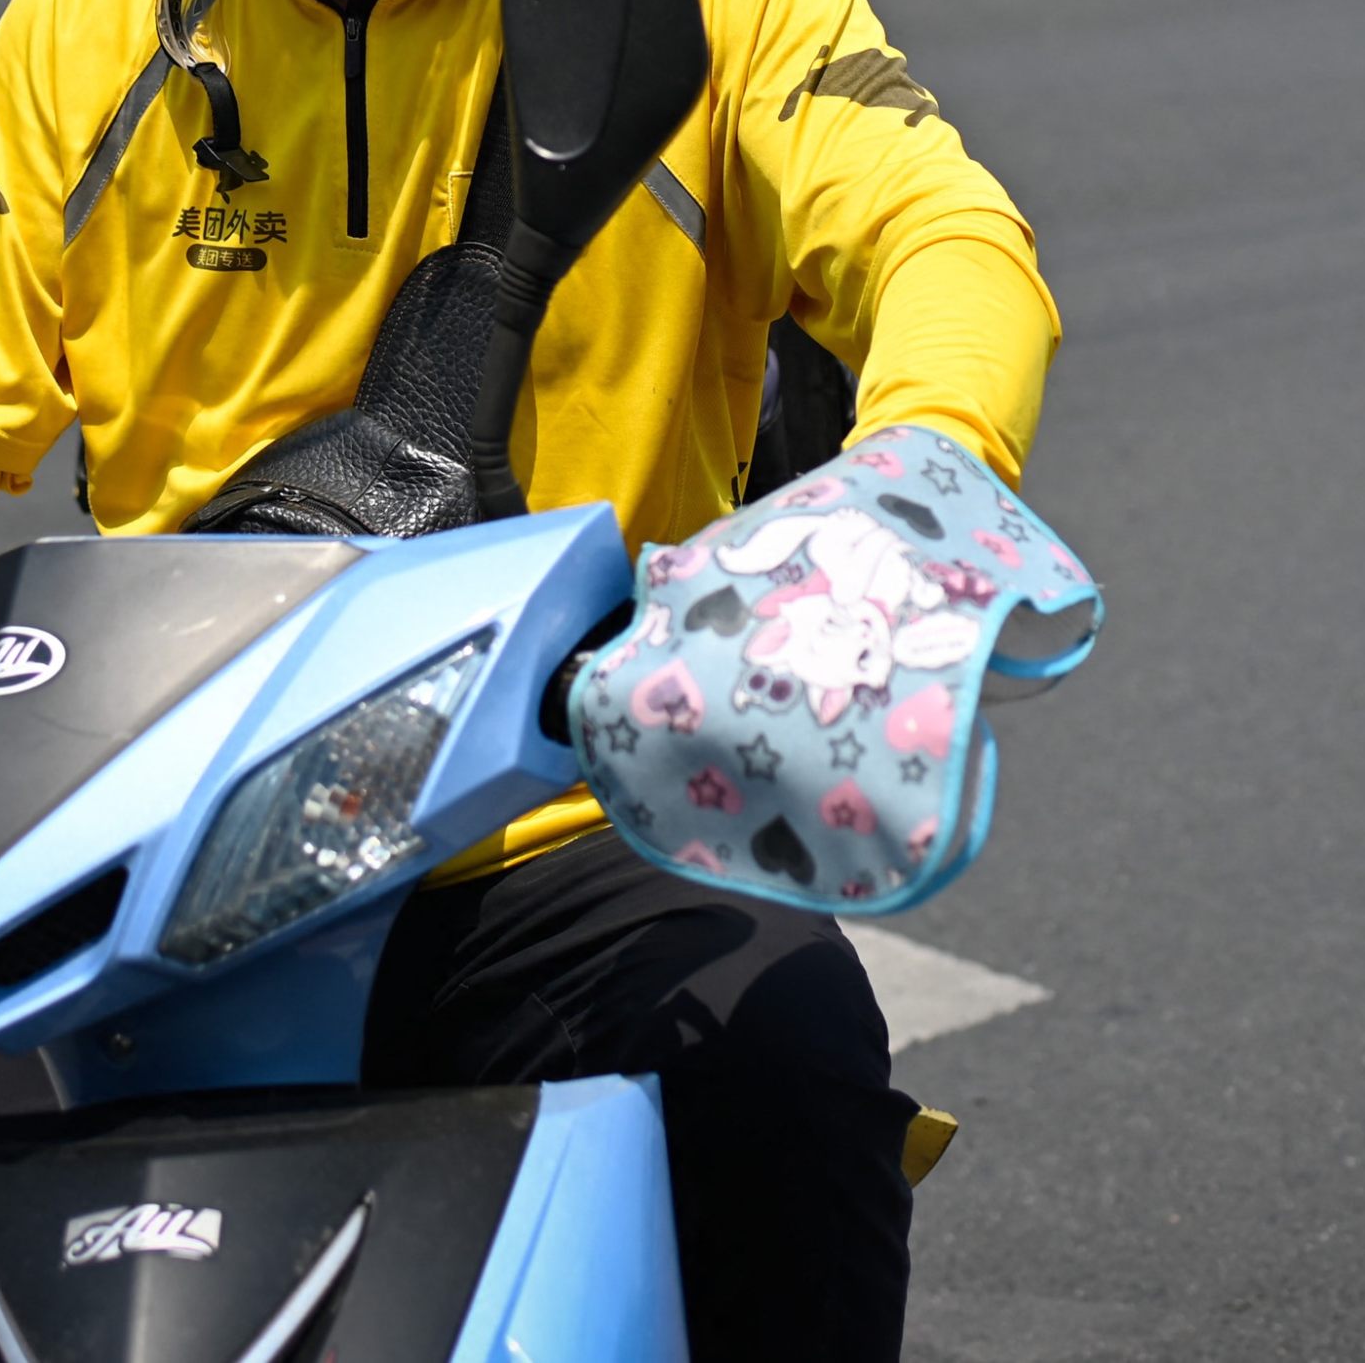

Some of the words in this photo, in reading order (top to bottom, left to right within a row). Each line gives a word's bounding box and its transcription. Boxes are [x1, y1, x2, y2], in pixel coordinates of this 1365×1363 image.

[172, 206, 288, 244] 美团外卖
[196, 248, 254, 268] 美团专送
